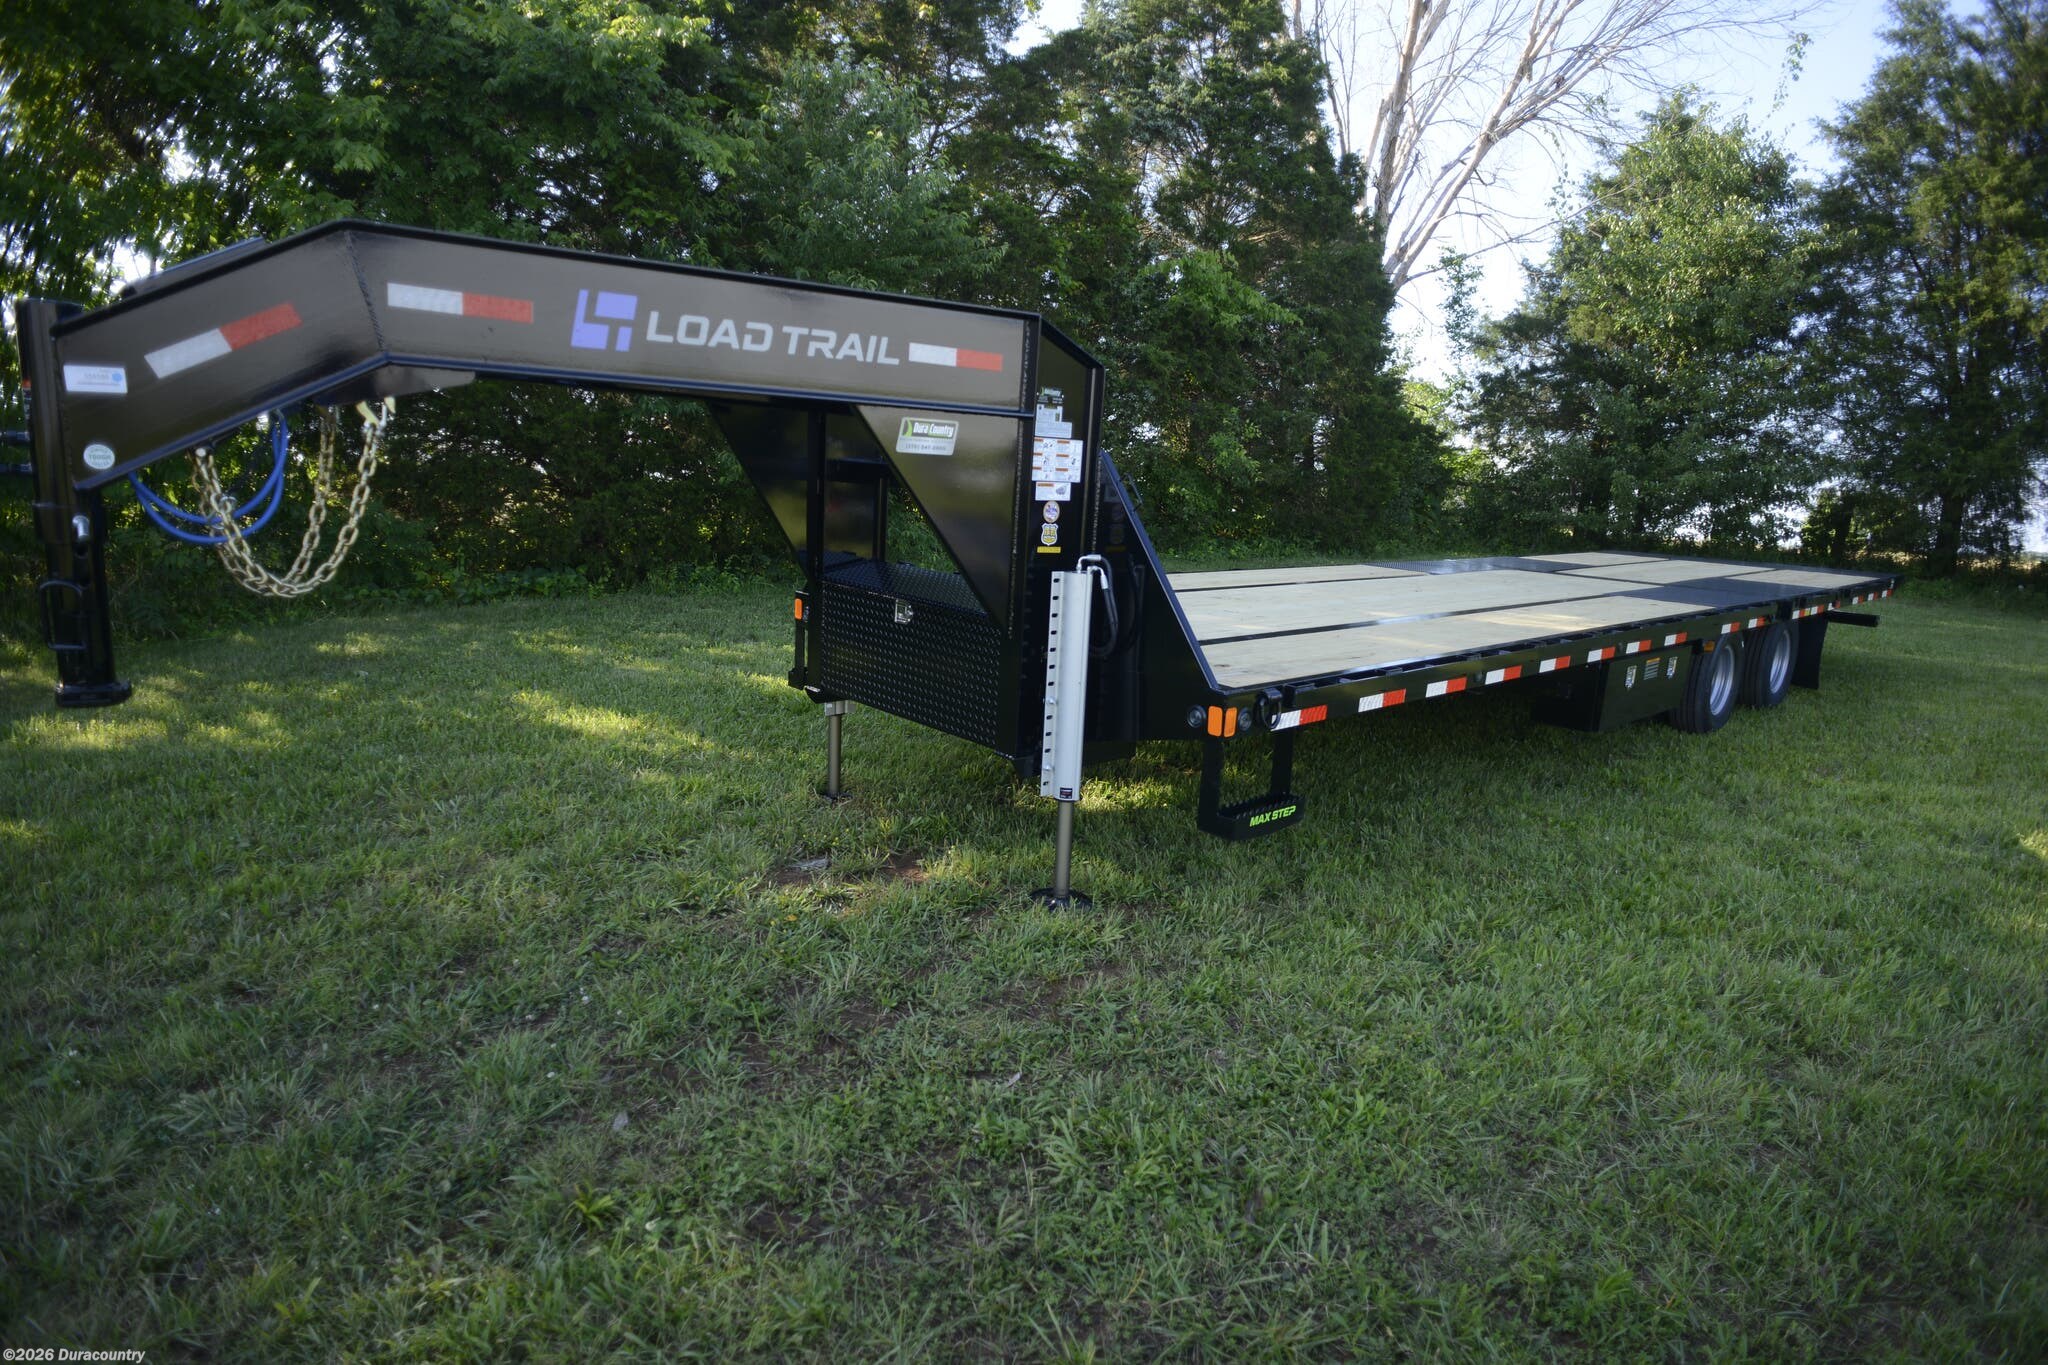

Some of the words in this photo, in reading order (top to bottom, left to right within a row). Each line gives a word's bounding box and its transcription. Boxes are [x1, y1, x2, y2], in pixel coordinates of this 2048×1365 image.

[646, 311, 773, 352] LOAD
[782, 326, 900, 365] TRAIL
[913, 422, 929, 434] Dura
[929, 423, 954, 437] Country
[1250, 812, 1271, 827] MAX
[1272, 805, 1296, 820] STEP
